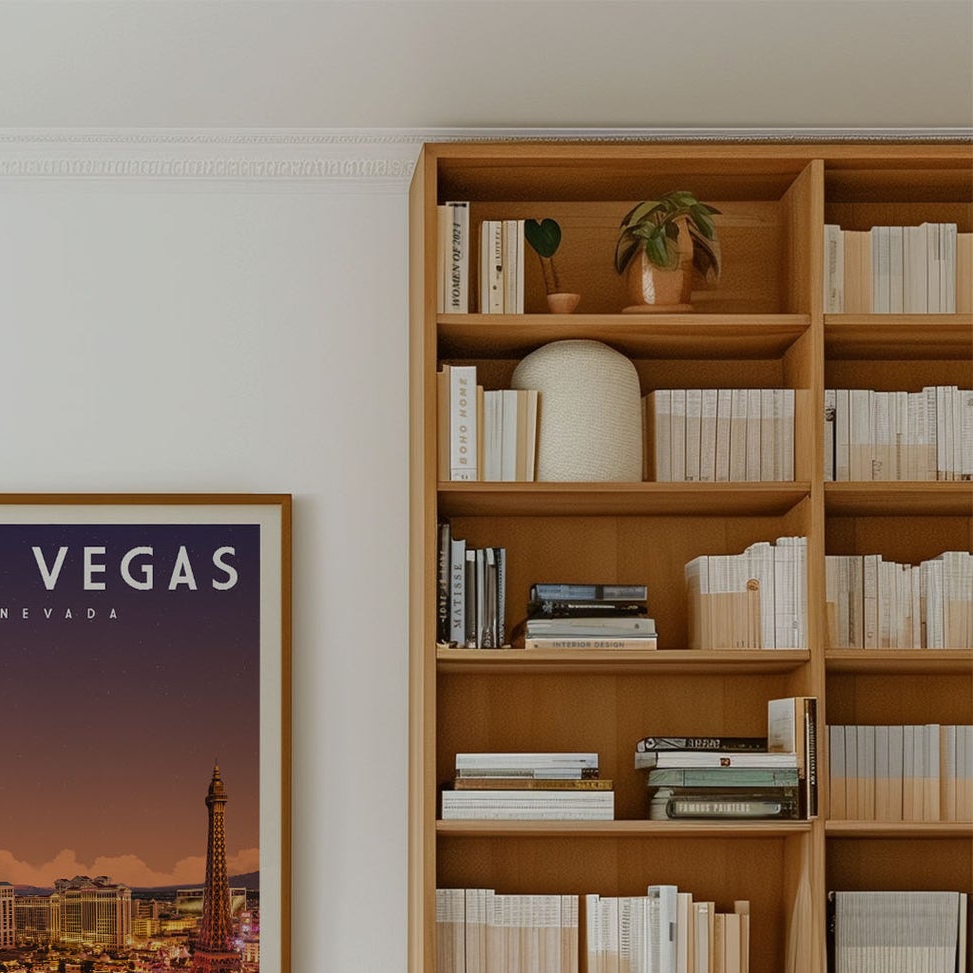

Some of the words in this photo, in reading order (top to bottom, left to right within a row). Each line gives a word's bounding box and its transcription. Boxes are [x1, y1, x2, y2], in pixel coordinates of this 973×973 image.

[453, 246, 461, 262] OF
[452, 263, 461, 307] WOMEN
[459, 377, 467, 418] HOME
[459, 425, 467, 465] BOHO
[31, 545, 239, 591] VEGAS
[0, 608, 119, 619] NEVADA
[454, 564, 462, 629] MATISSE
[678, 803, 710, 812] FAMOUS
[713, 803, 750, 812] PAINTERS
